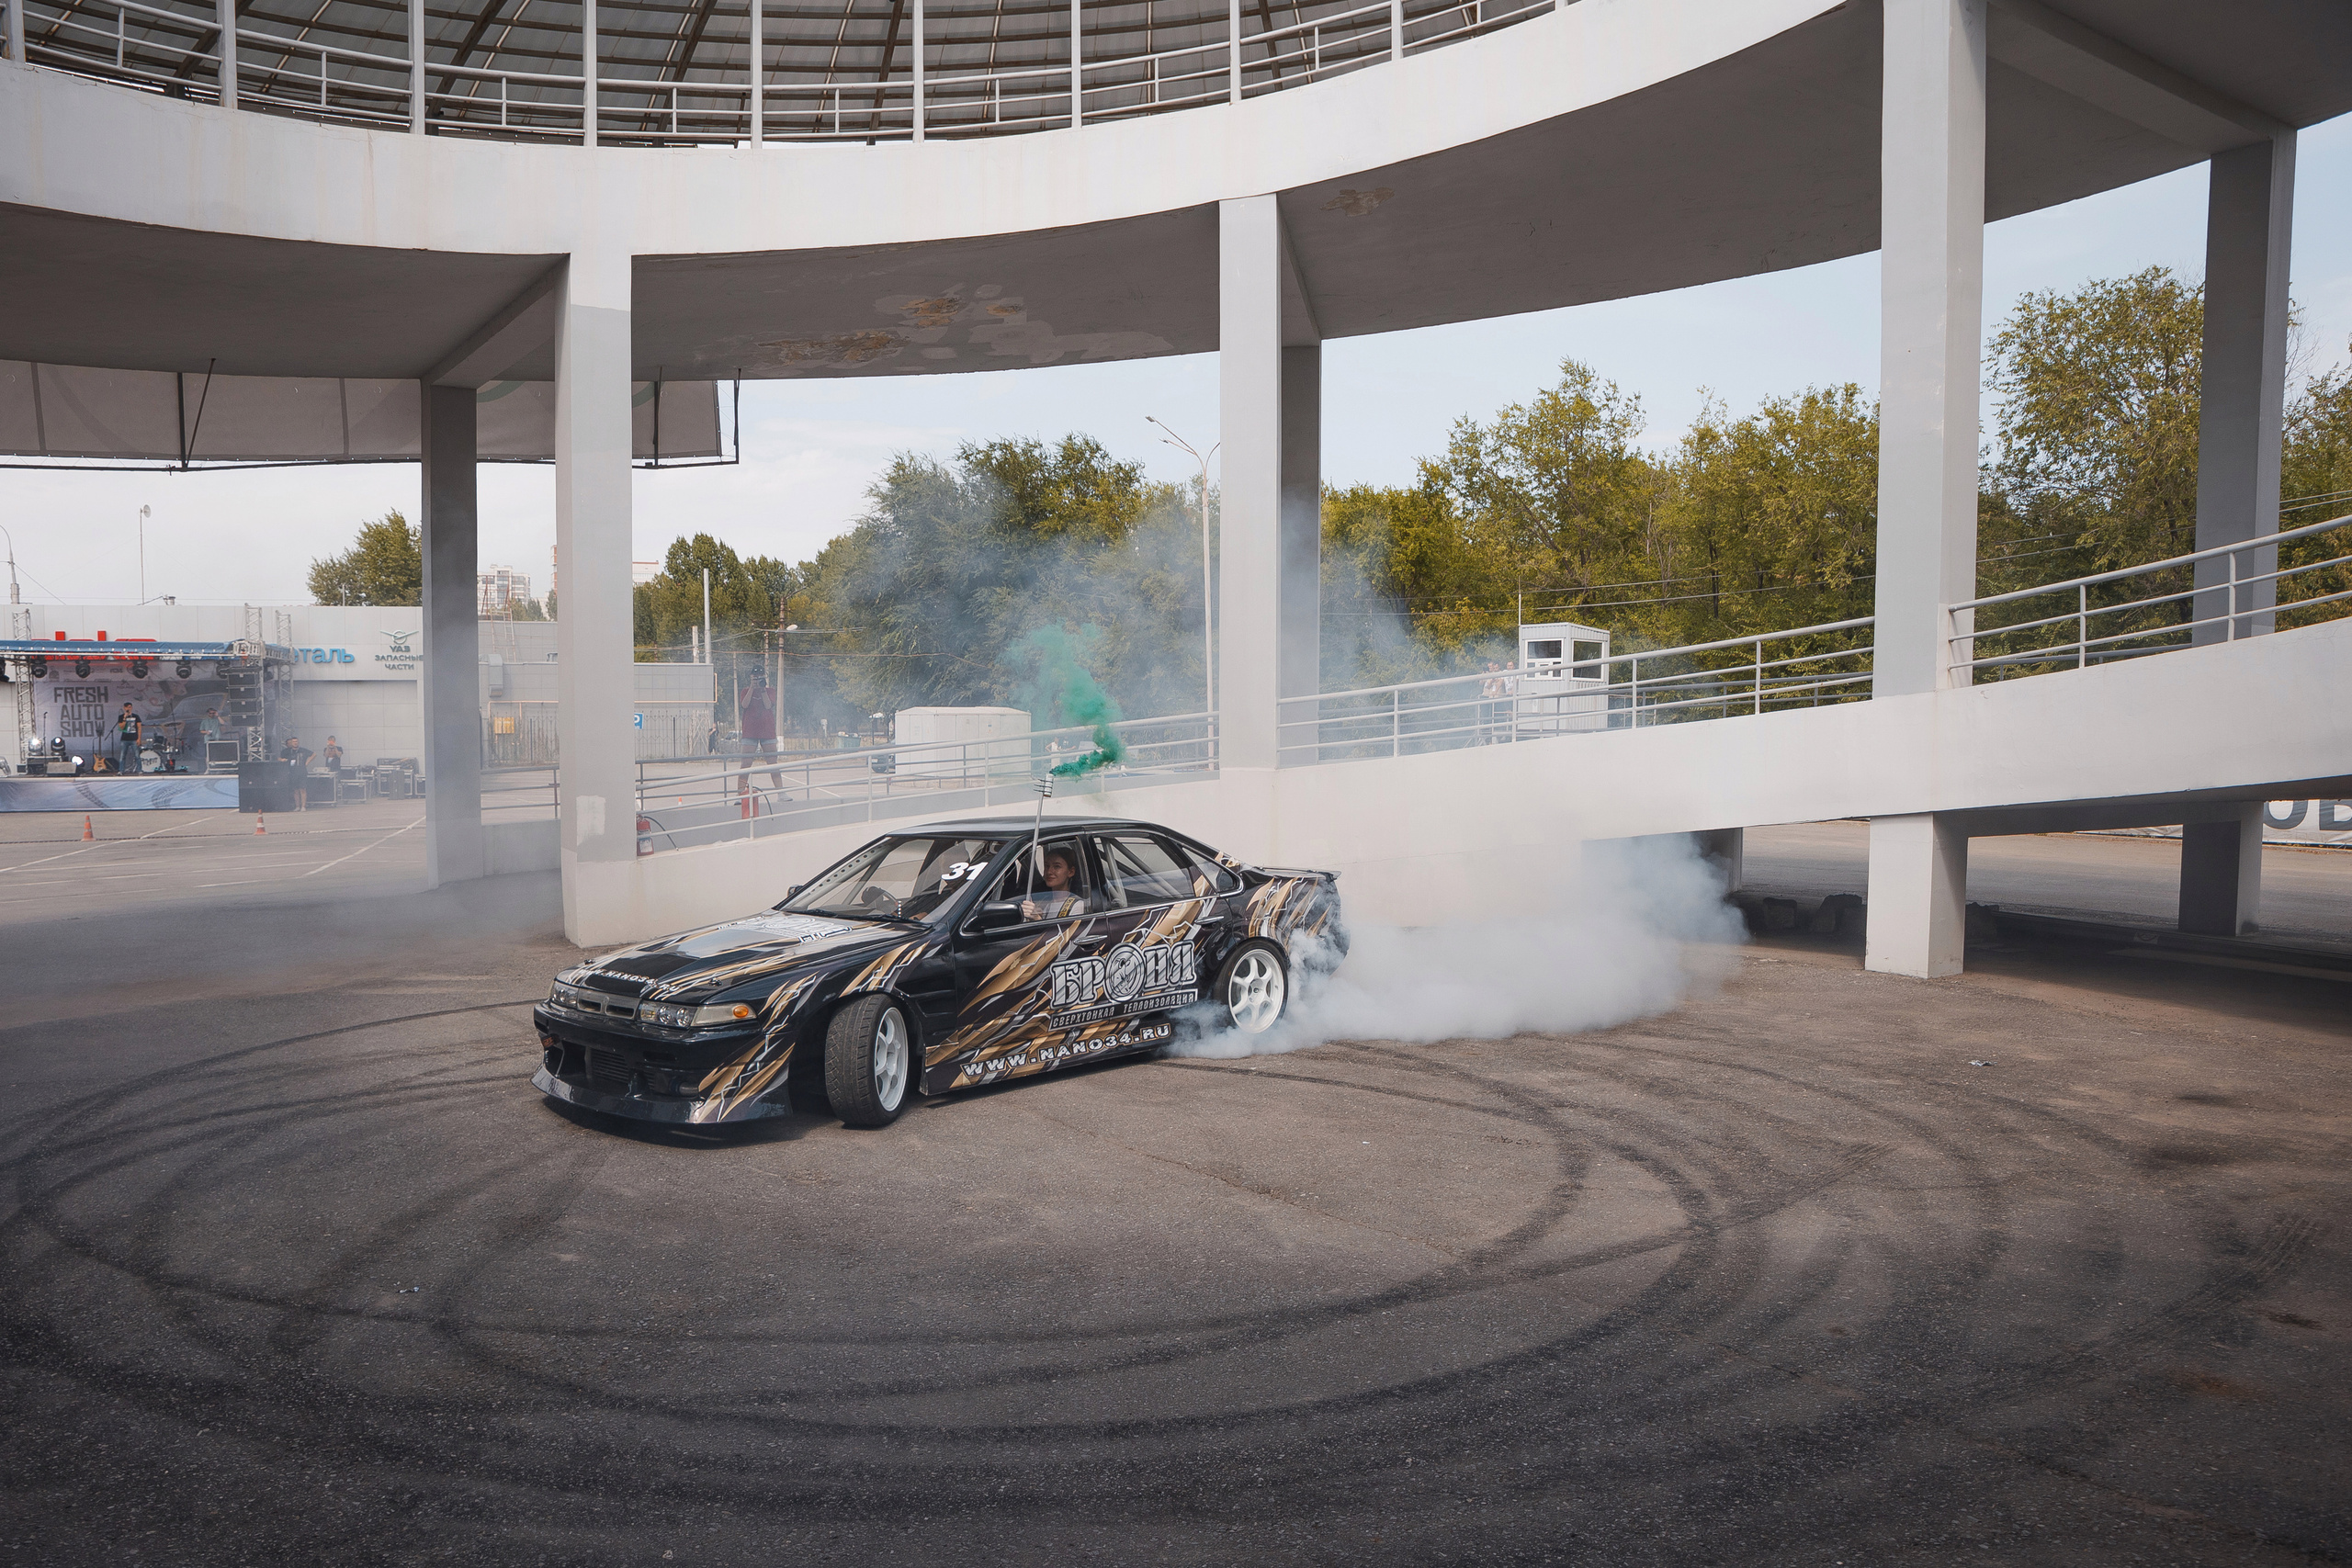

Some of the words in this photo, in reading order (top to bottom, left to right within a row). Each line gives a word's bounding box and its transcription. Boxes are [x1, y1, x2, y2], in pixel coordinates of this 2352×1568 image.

[53, 686, 108, 704] FRESH
[61, 704, 105, 720] AUTO
[61, 721, 105, 738] SHOW
[942, 862, 989, 881] 31
[1050, 940, 1197, 1010] БРОНЯ
[1052, 1007, 1115, 1028] СВЕРХТОНКАЯ
[1123, 993, 1194, 1014] ТЕПЛОИЗОЛЯЦИЯ
[962, 1024, 1171, 1077] WWW.NANO34.RU
